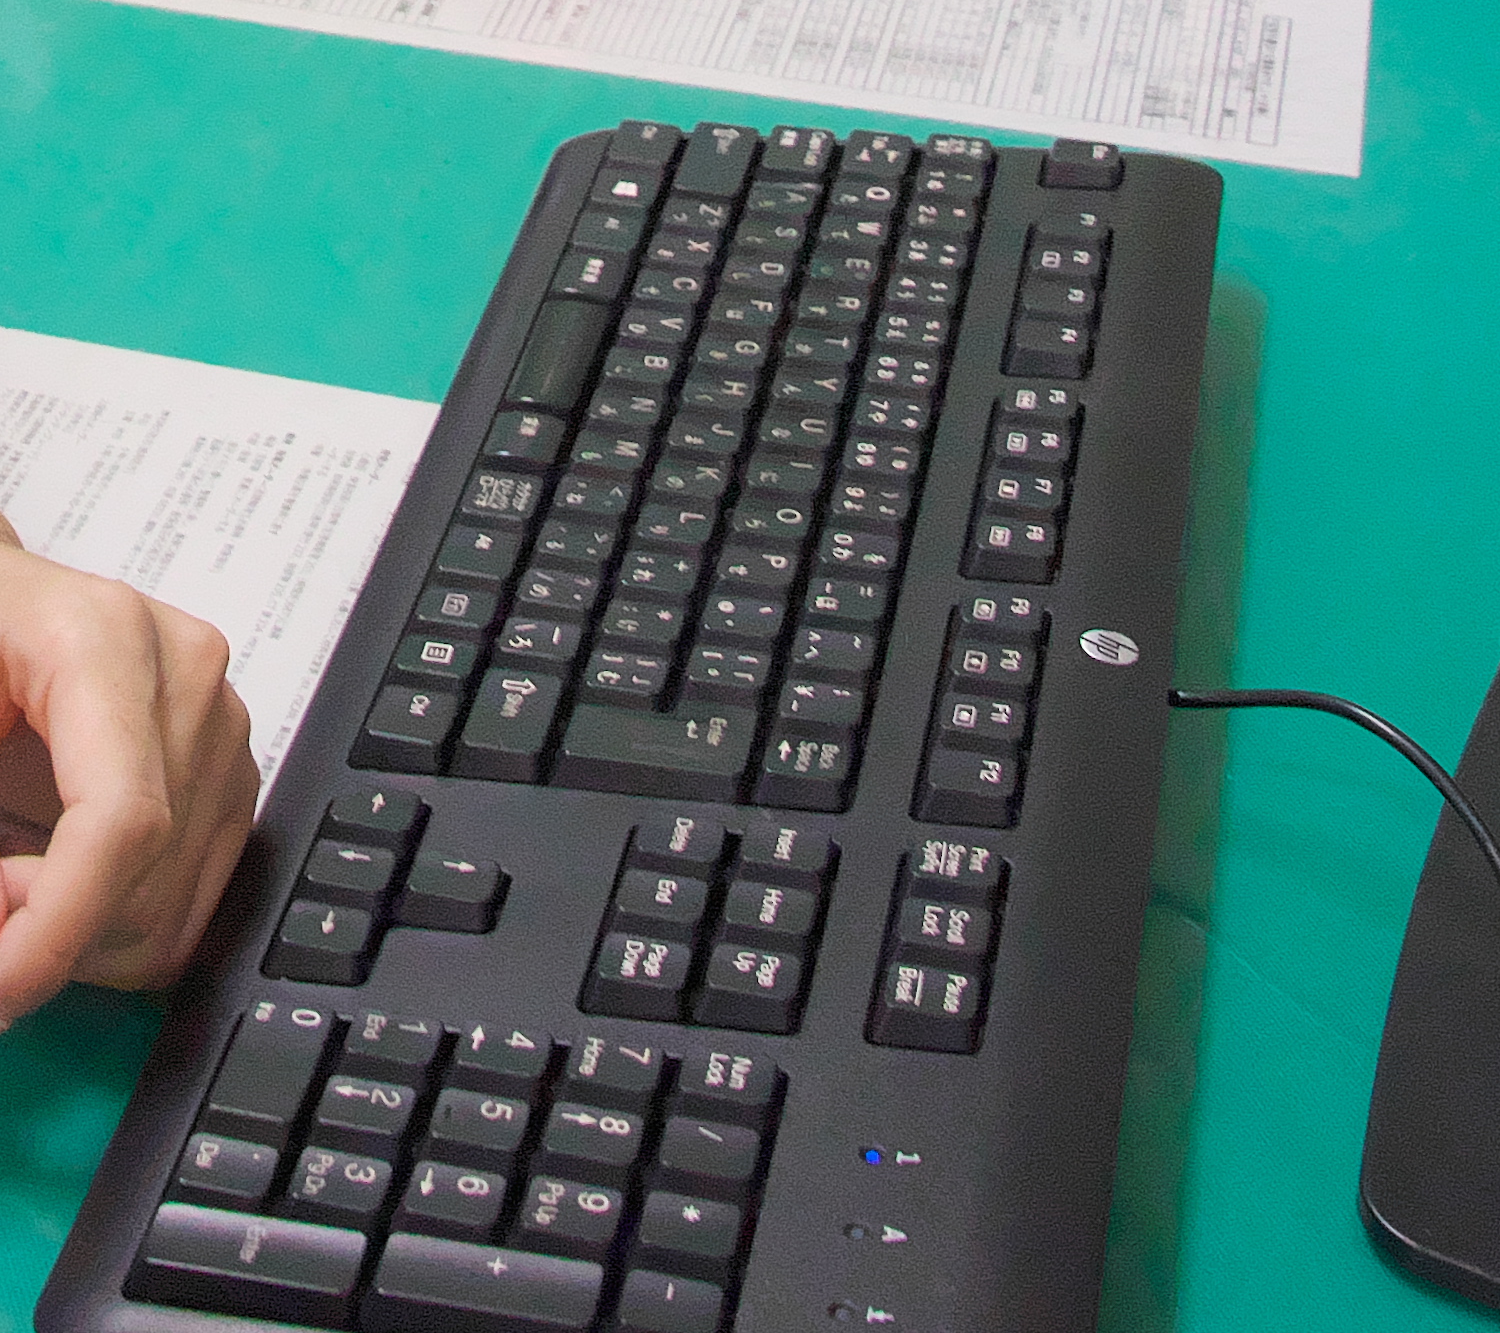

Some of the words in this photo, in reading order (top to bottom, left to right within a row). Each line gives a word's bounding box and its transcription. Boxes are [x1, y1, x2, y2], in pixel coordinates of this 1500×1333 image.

[735, 339, 761, 356] G
[721, 380, 747, 397] H
[630, 396, 657, 412] N
[614, 439, 640, 458] M
[1035, 478, 1052, 495] F7
[776, 508, 802, 525] O
[773, 827, 798, 861] Insert
[655, 879, 678, 905] End
[759, 887, 784, 924] Home
[922, 905, 945, 937] Lock
[946, 908, 972, 946] Scroll
[620, 939, 646, 978] Down
[643, 943, 669, 978] Page
[732, 951, 757, 974] Up
[756, 954, 782, 989] Page
[895, 965, 918, 1003] Break
[943, 973, 969, 1014] Pause
[291, 1008, 322, 1027] 0
[505, 1031, 536, 1050] 4
[578, 1037, 605, 1076] Home
[619, 1046, 650, 1065] 7
[705, 1052, 730, 1086] Lock
[729, 1057, 752, 1090] Num
[371, 1088, 401, 1109] 2
[481, 1100, 513, 1120] 5
[599, 1116, 631, 1136] 8
[344, 1162, 376, 1184] 3
[457, 1175, 490, 1196] 6
[577, 1192, 610, 1213] 9
